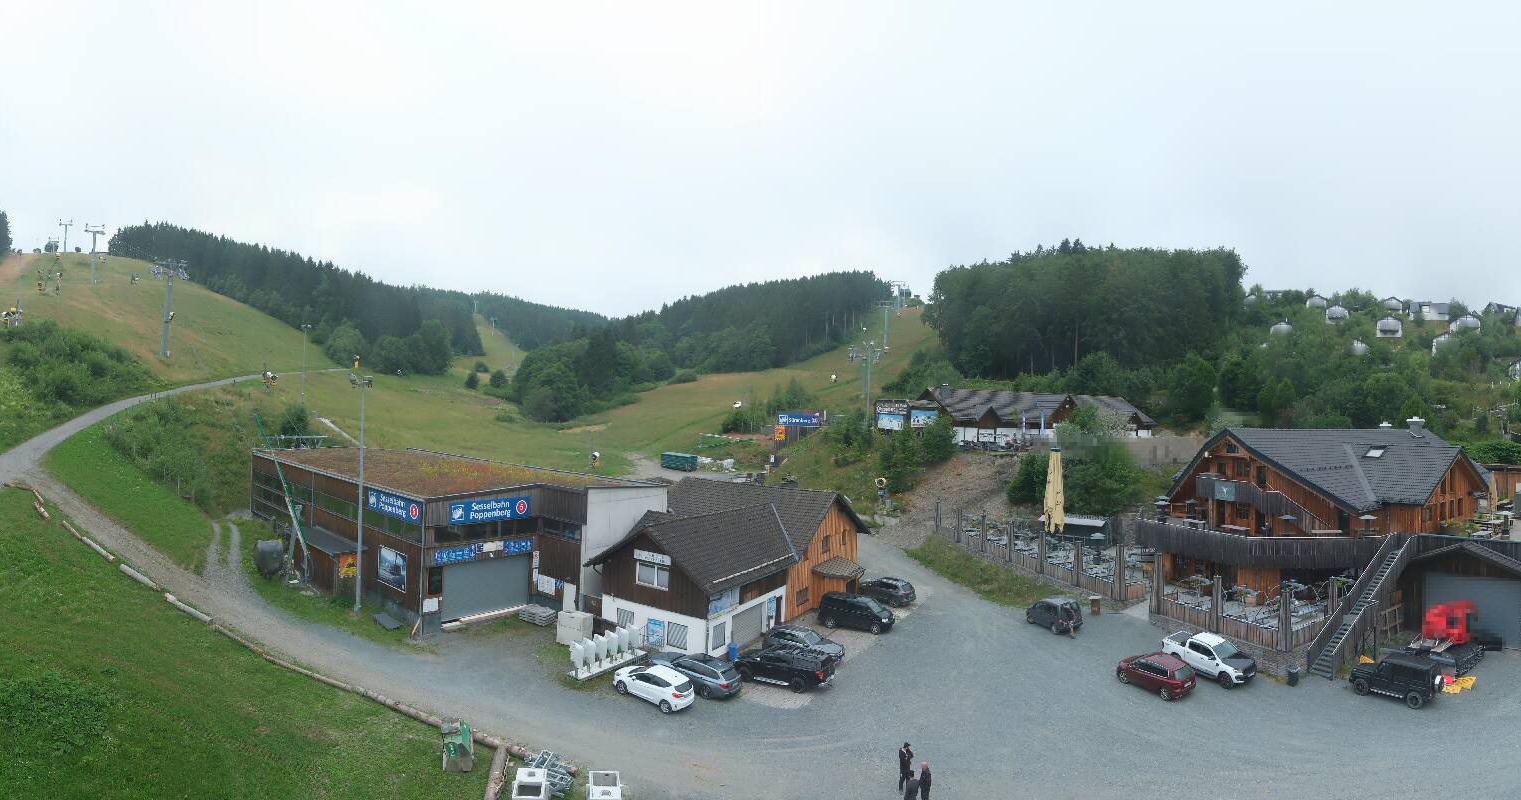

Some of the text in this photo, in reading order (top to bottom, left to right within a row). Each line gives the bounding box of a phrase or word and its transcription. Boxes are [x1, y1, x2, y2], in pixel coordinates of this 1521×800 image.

[380, 493, 406, 508] Sesselbahn
[471, 501, 510, 511] Sesselbahn
[378, 502, 407, 518] Poppenberg
[519, 503, 524, 511] 5
[470, 509, 511, 520] Poppenberg
